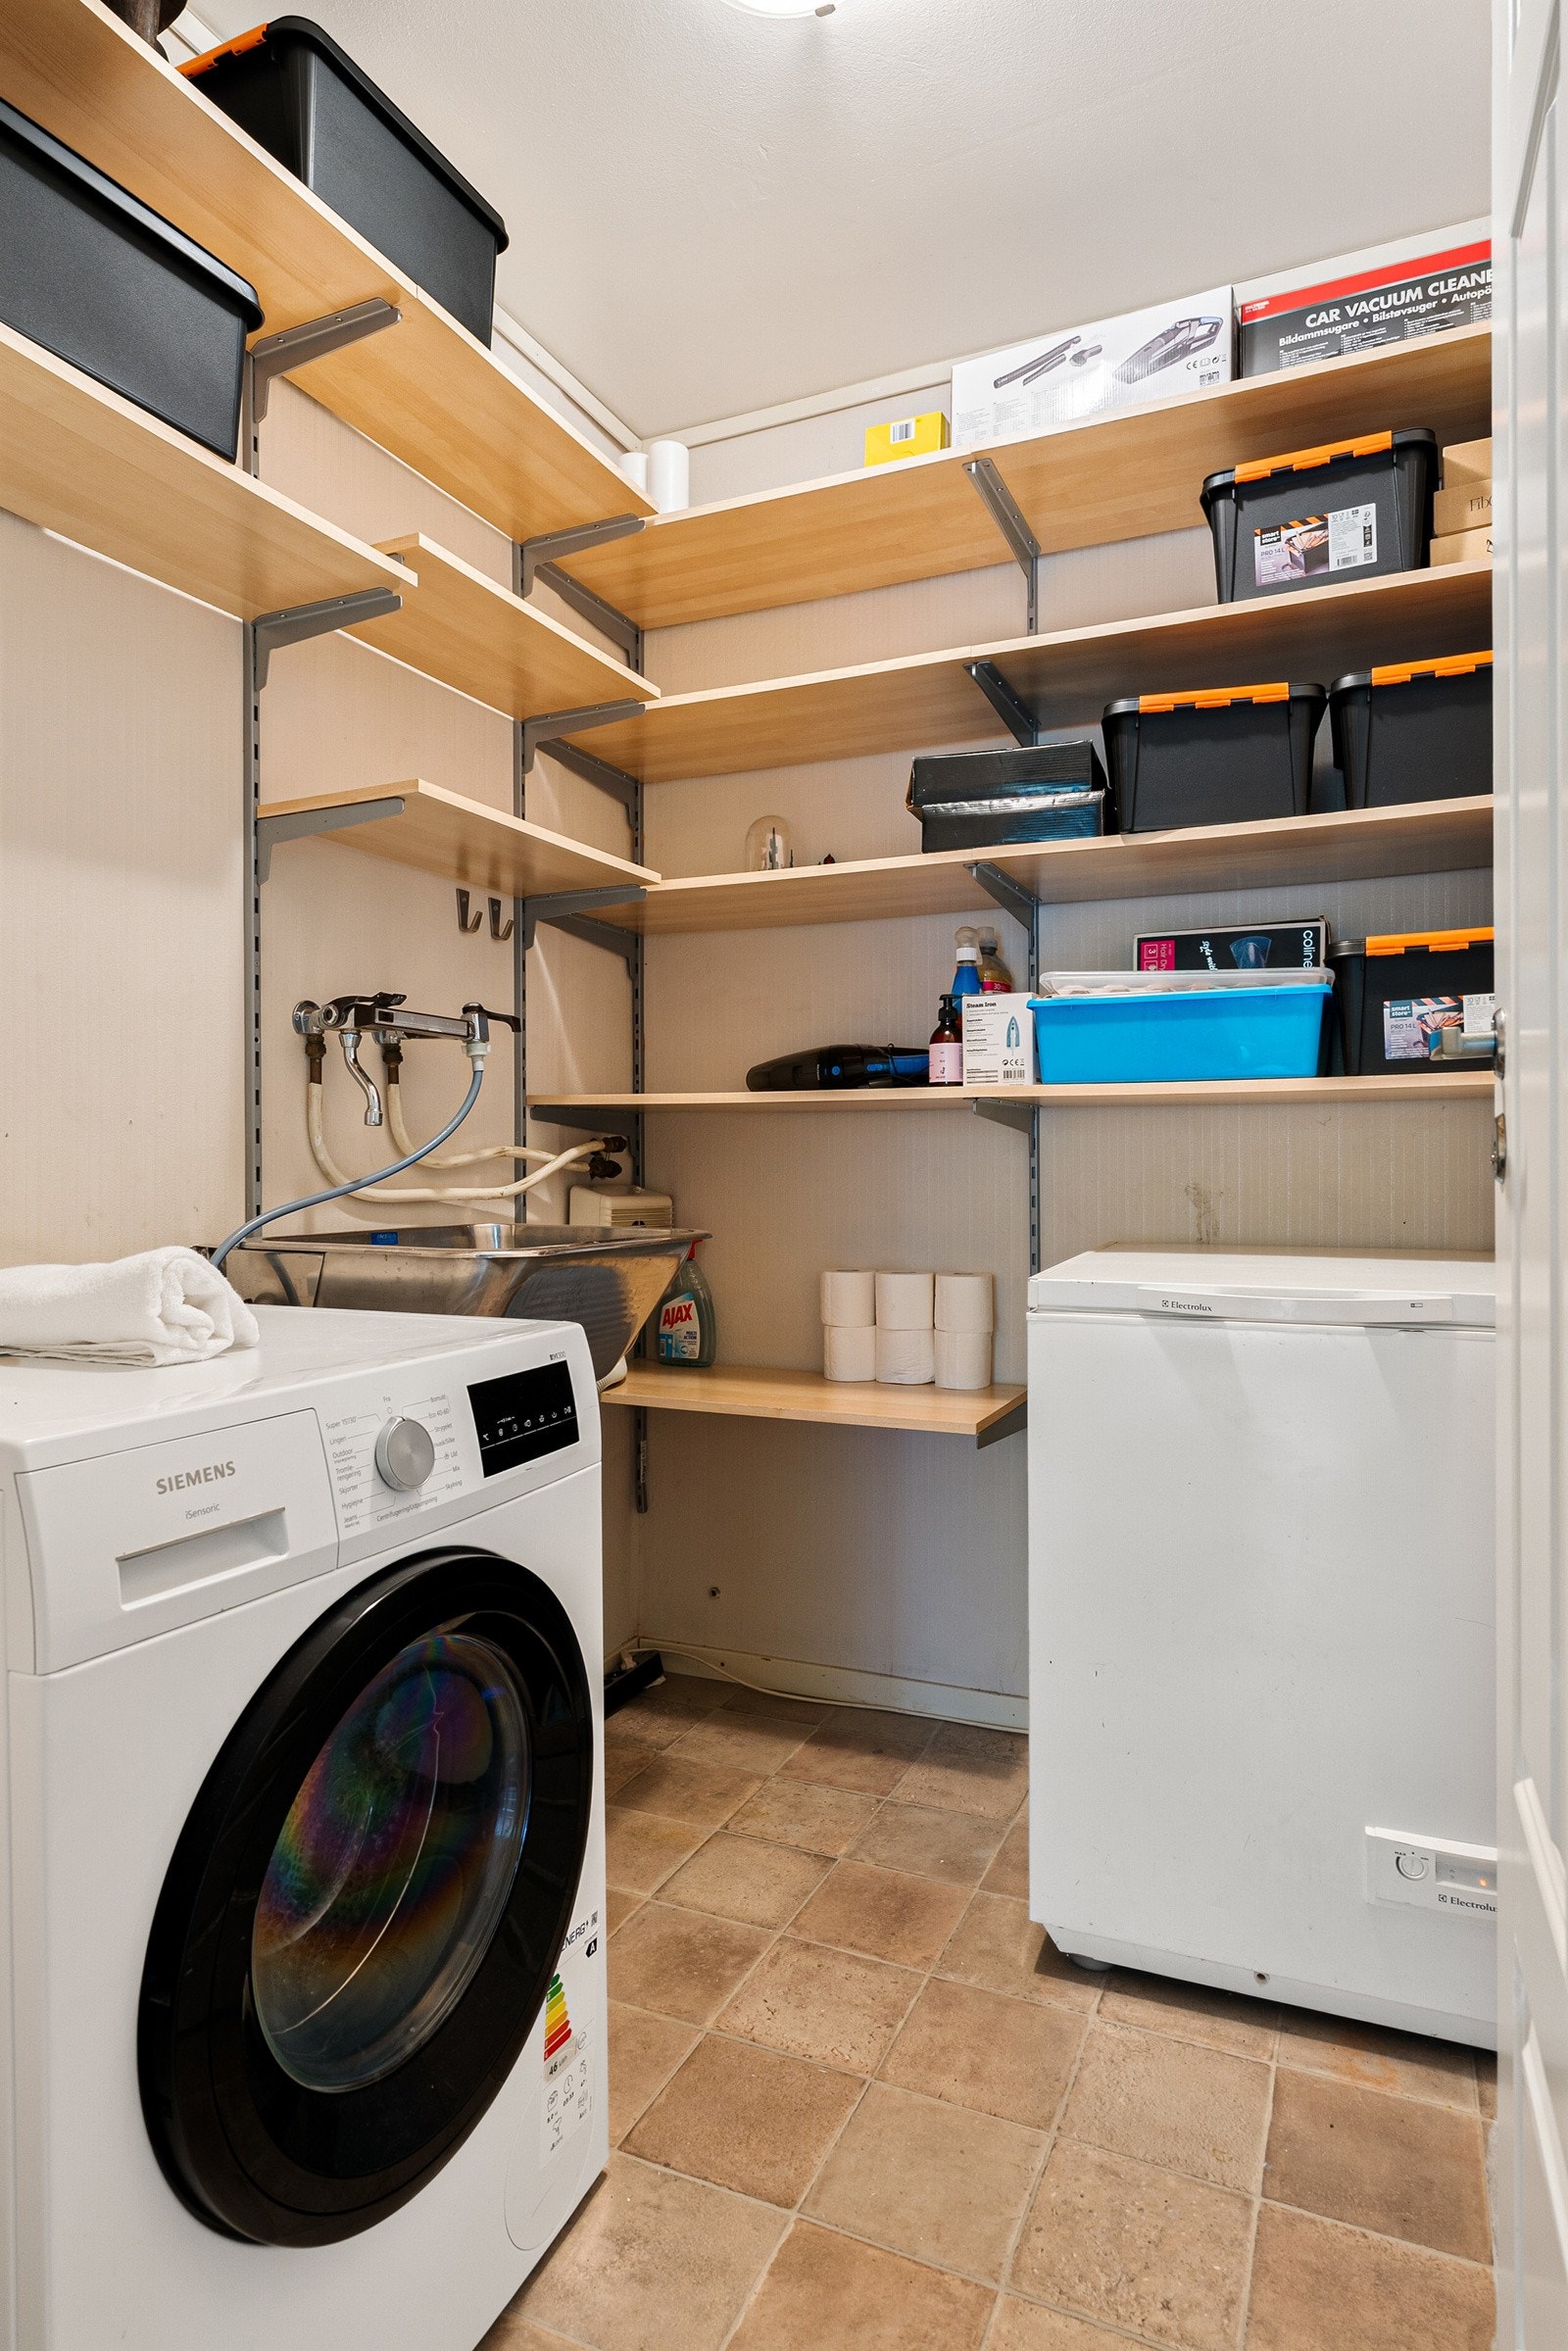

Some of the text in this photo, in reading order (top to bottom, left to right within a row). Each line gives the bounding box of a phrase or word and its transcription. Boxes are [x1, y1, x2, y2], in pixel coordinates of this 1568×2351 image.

[1305, 308, 1342, 328] CAR
[1345, 285, 1424, 318] VACUUM
[1279, 320, 1359, 346] Bildammsugare
[1372, 300, 1439, 324] Bilstøvsuger
[1261, 530, 1280, 539] smart
[1158, 943, 1167, 959] Hair
[1302, 930, 1313, 968] coline
[1171, 1300, 1212, 1311] Electrolux
[662, 1302, 693, 1329] AJAX
[332, 1448, 353, 1458] Outdoor
[156, 1461, 236, 1495] SIEMENS
[339, 1485, 359, 1494] Skjorter
[185, 1503, 220, 1519] iSensoric
[589, 1941, 596, 1955] A
[549, 2061, 559, 2076] 46
